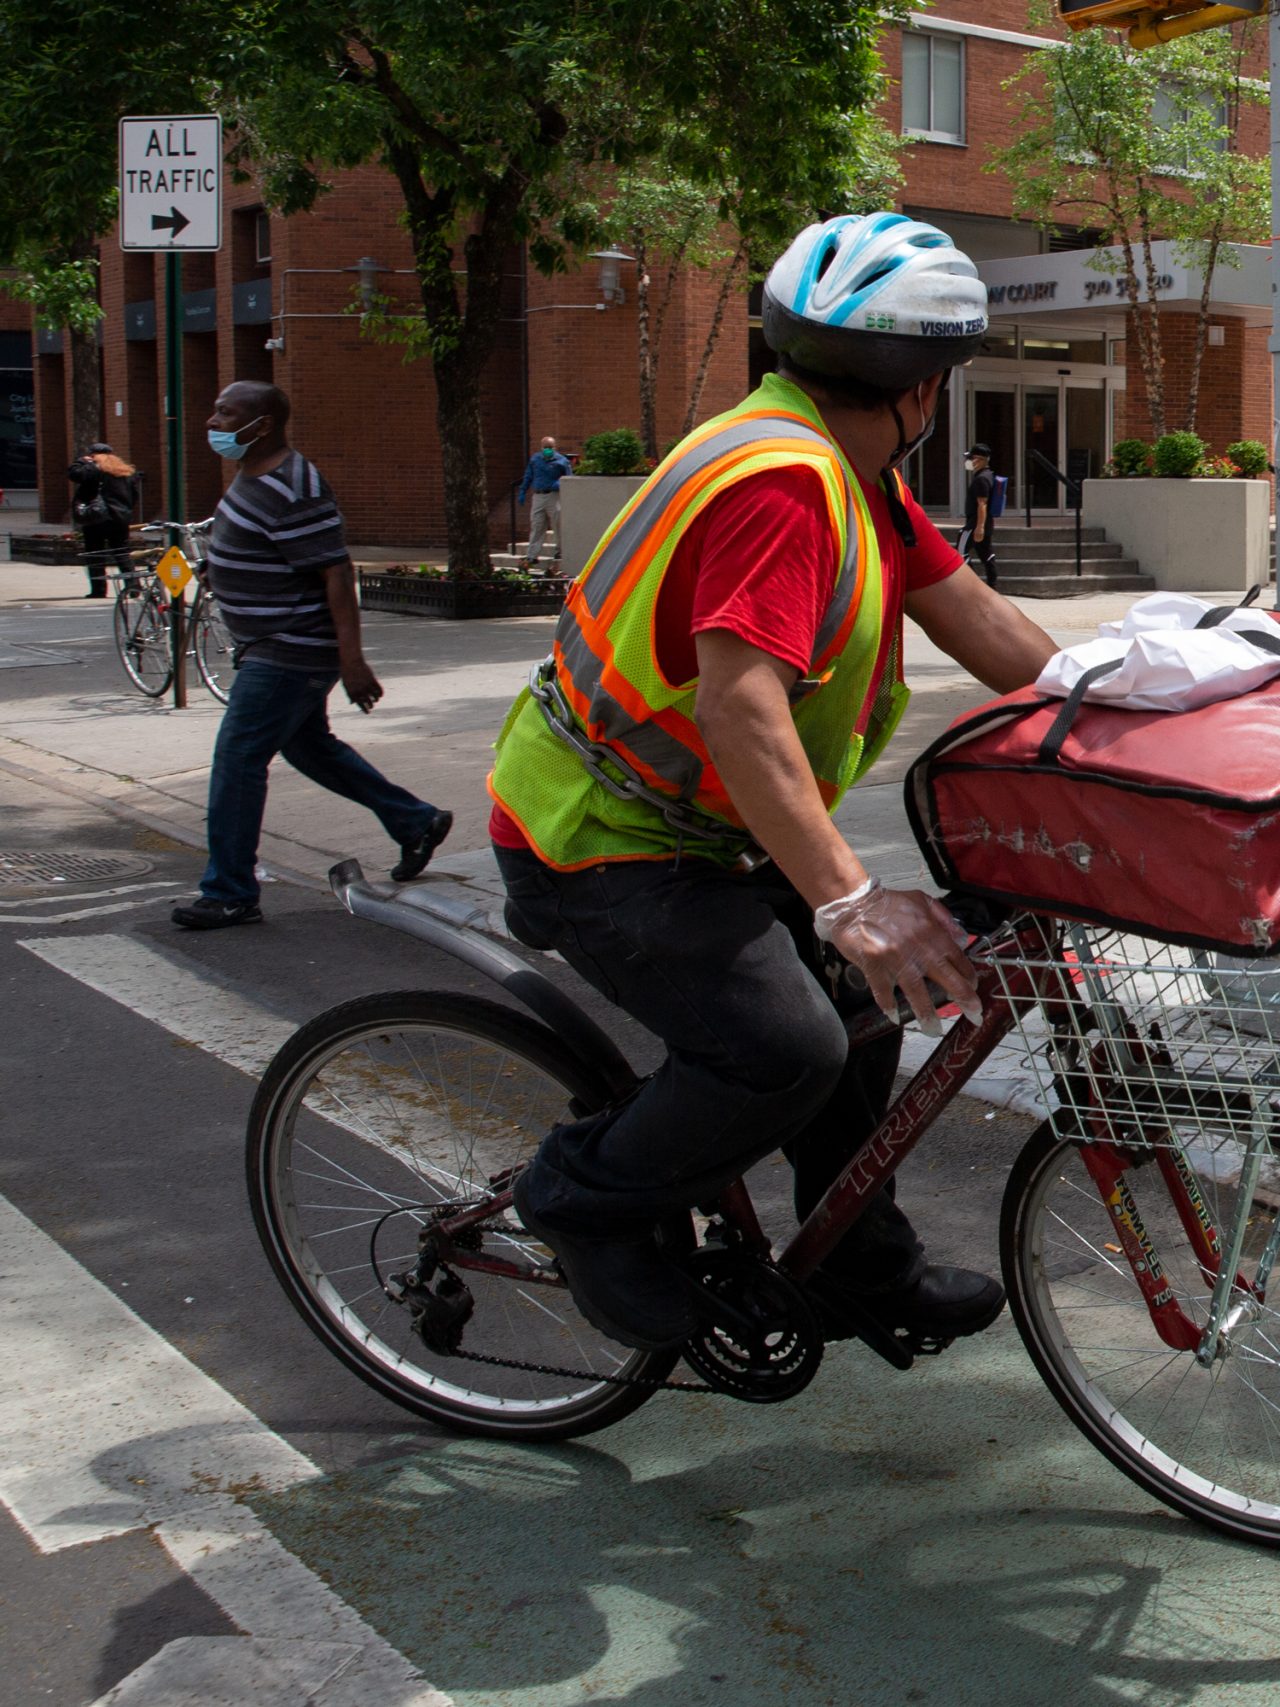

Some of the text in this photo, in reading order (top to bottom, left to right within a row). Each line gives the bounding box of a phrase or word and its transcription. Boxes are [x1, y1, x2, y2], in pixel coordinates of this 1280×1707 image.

[145, 128, 197, 157] ALL
[126, 168, 216, 194] TRAFFIC
[1007, 280, 1058, 303] COURT
[866, 316, 895, 330] DOT
[920, 319, 964, 336] VISION
[840, 1026, 976, 1196] TREK
